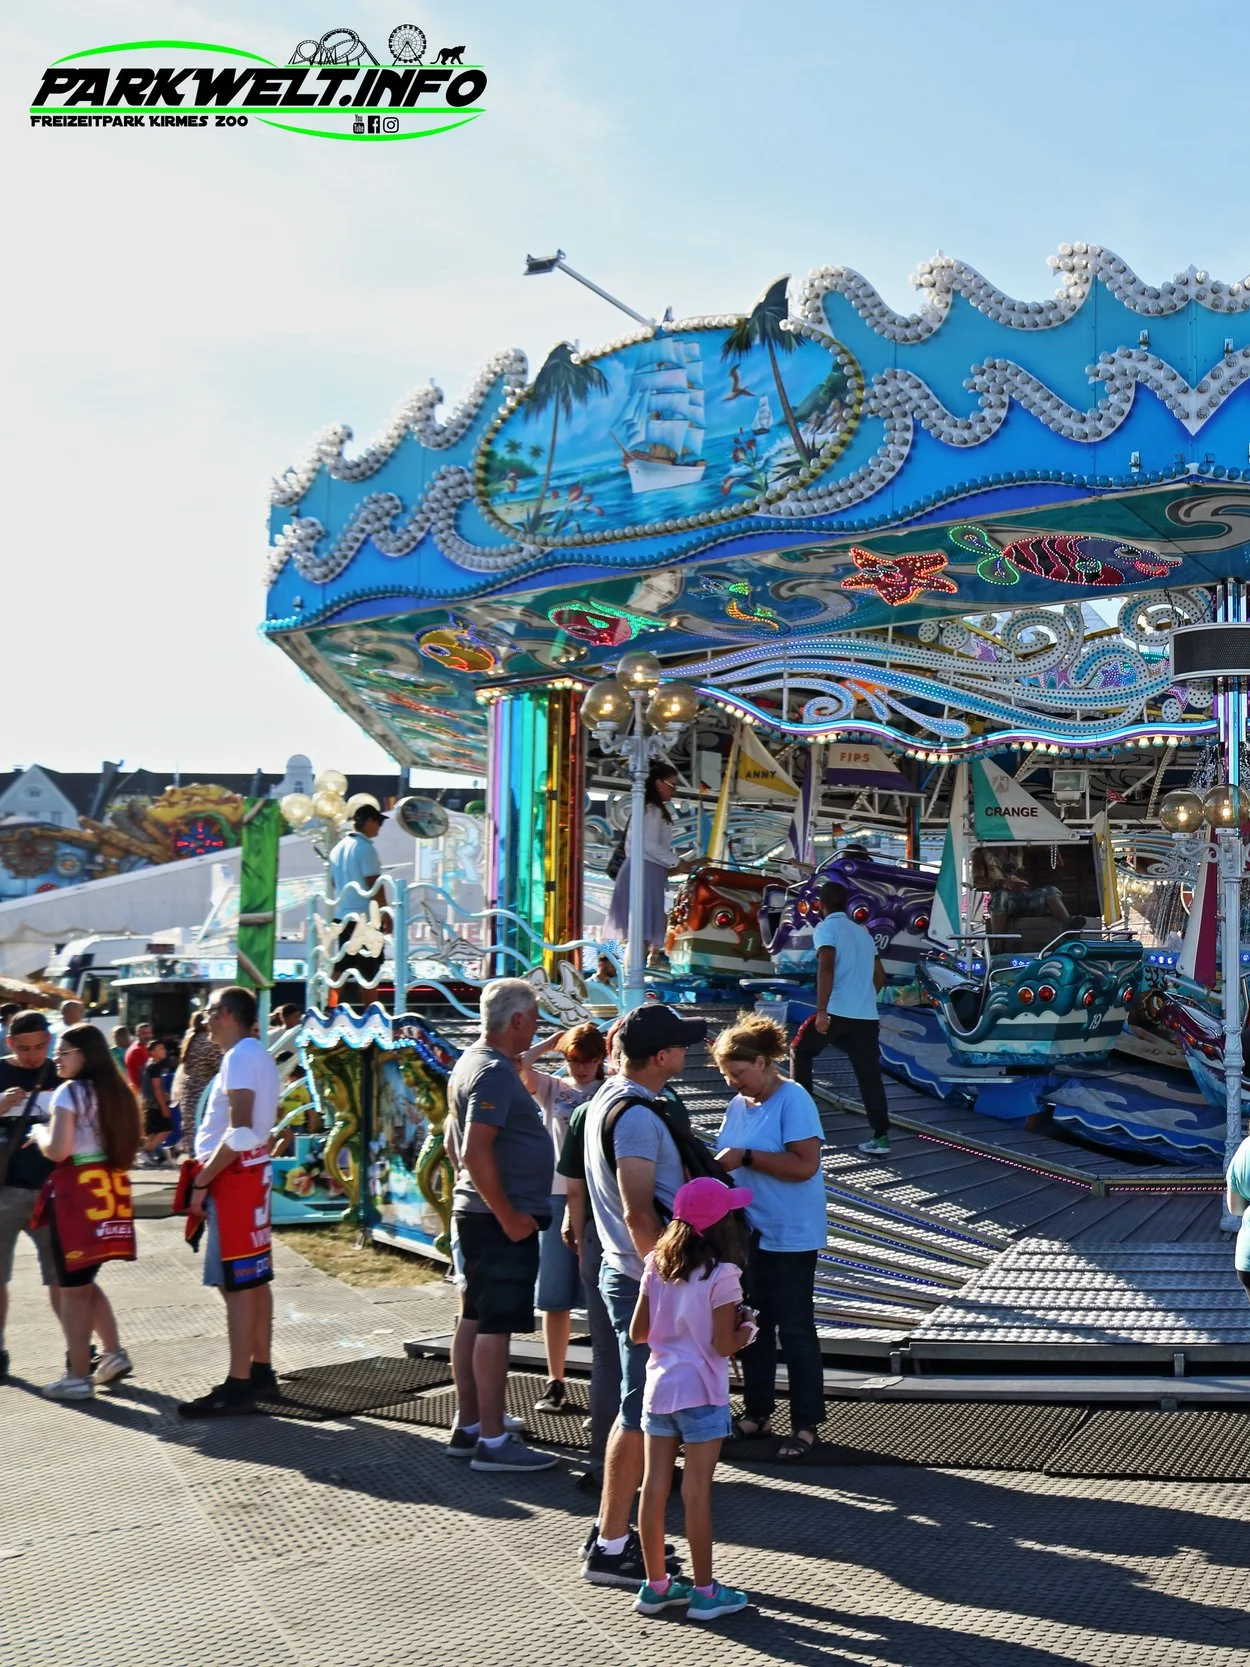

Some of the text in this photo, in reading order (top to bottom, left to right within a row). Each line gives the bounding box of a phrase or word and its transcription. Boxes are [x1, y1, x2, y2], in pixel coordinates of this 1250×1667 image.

[840, 752, 870, 763] FIPS
[745, 770, 777, 779] ANNY
[984, 806, 1038, 817] CRANGE
[746, 937, 753, 951] 1
[874, 933, 890, 950] 20
[1088, 1013, 1102, 1029] 19
